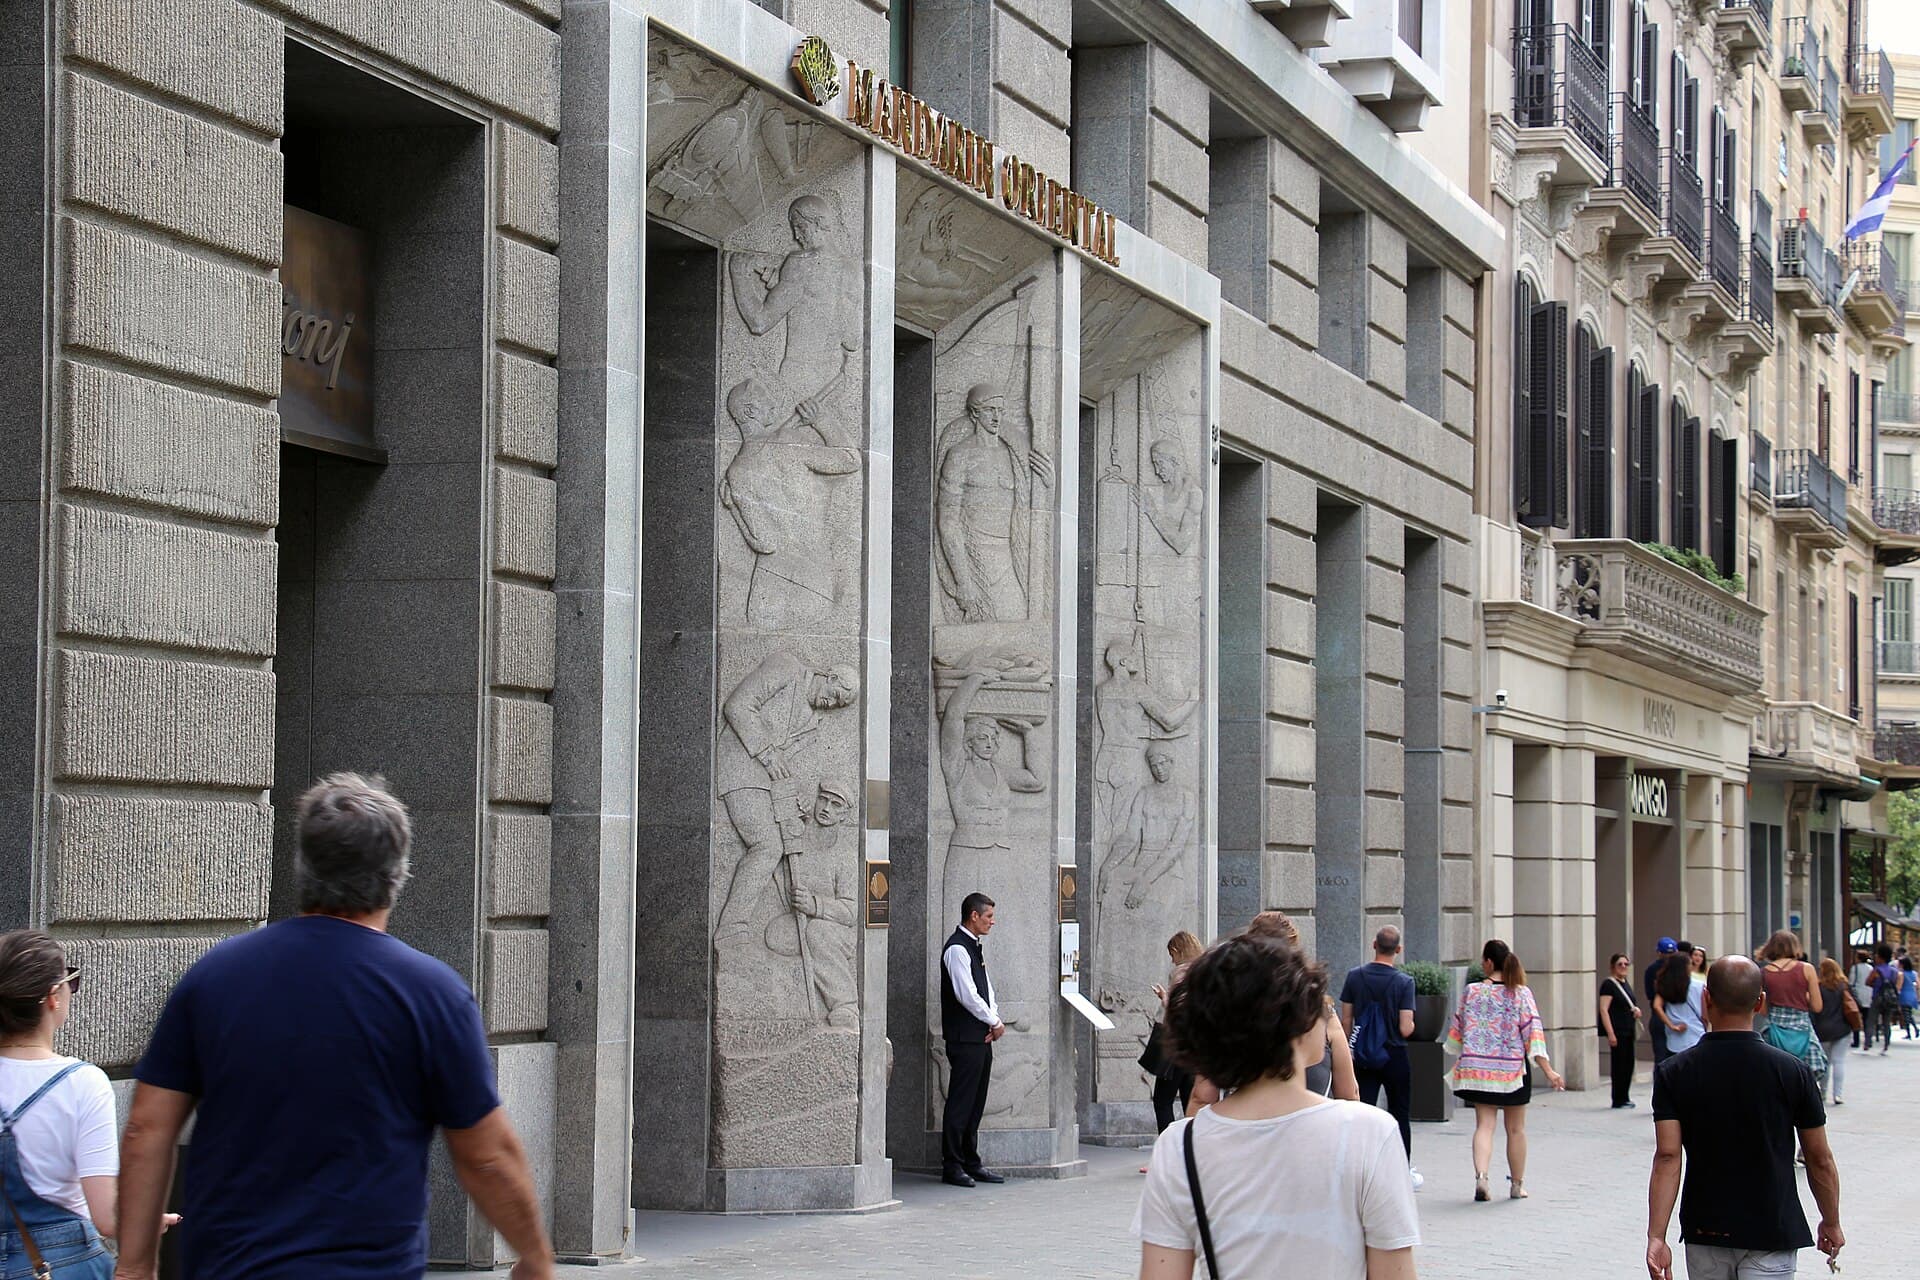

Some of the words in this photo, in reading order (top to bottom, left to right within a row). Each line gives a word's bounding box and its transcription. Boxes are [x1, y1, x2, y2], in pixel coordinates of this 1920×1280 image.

[846, 60, 995, 199] MANDARIN
[1001, 154, 1120, 267] ORIENTAL
[1630, 774, 1667, 817] MANGO
